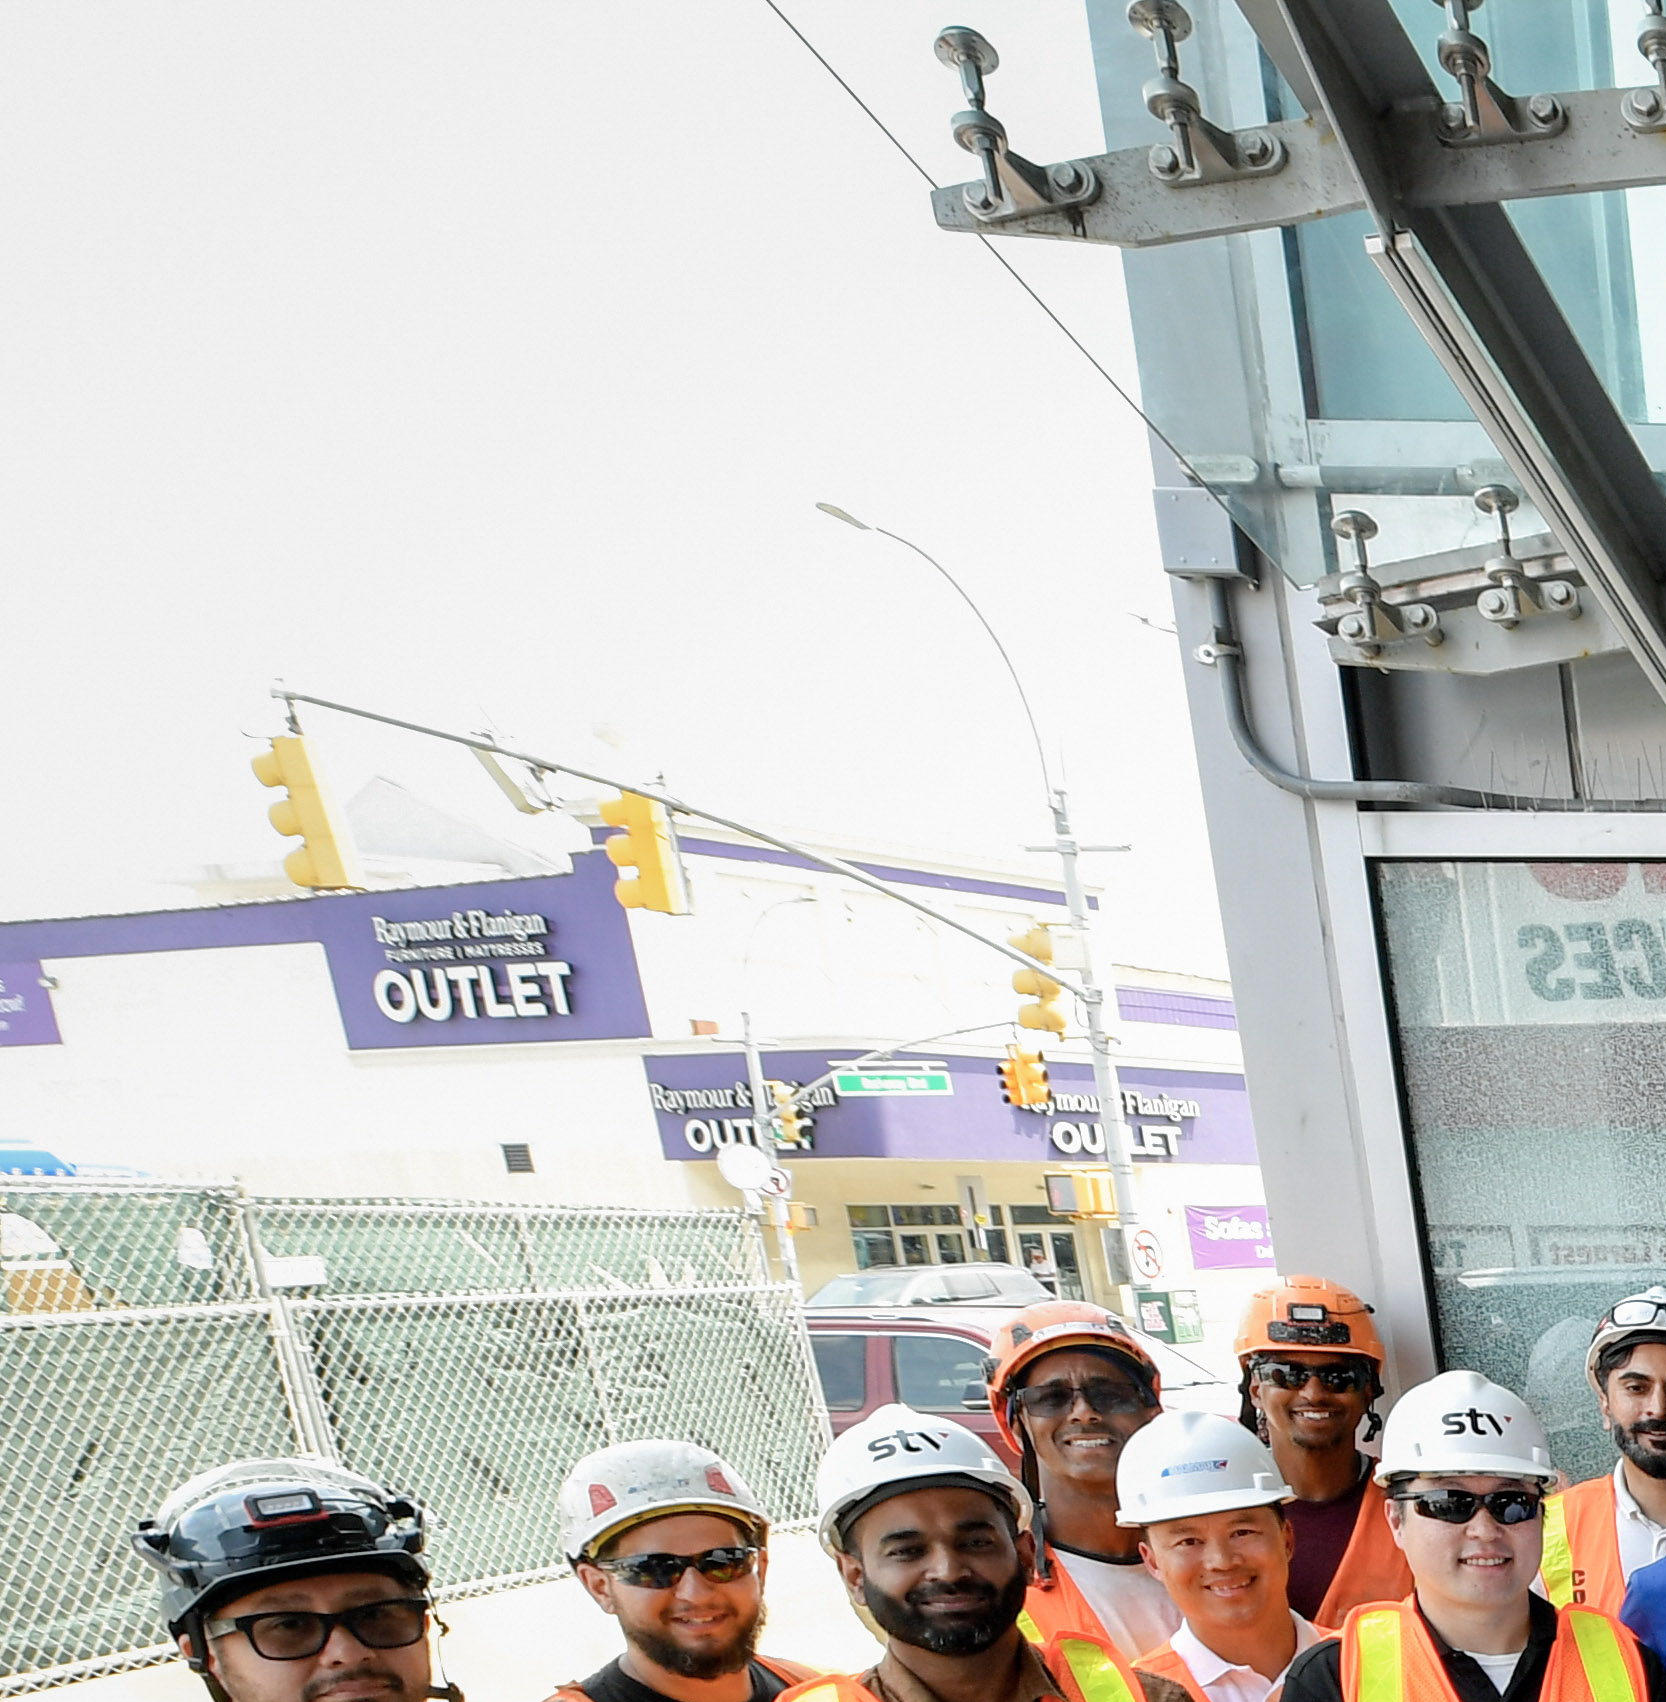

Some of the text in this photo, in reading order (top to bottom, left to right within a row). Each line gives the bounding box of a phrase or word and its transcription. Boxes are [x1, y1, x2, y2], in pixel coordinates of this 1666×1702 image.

[371, 916, 453, 948] Raymour
[467, 909, 549, 941] Flanigan
[372, 960, 573, 1024] OUTLET
[650, 1083, 733, 1114] Raymour
[1122, 1090, 1201, 1121] Flanigan
[1052, 1121, 1182, 1155] OULET
[1203, 1215, 1264, 1240] Sofas
